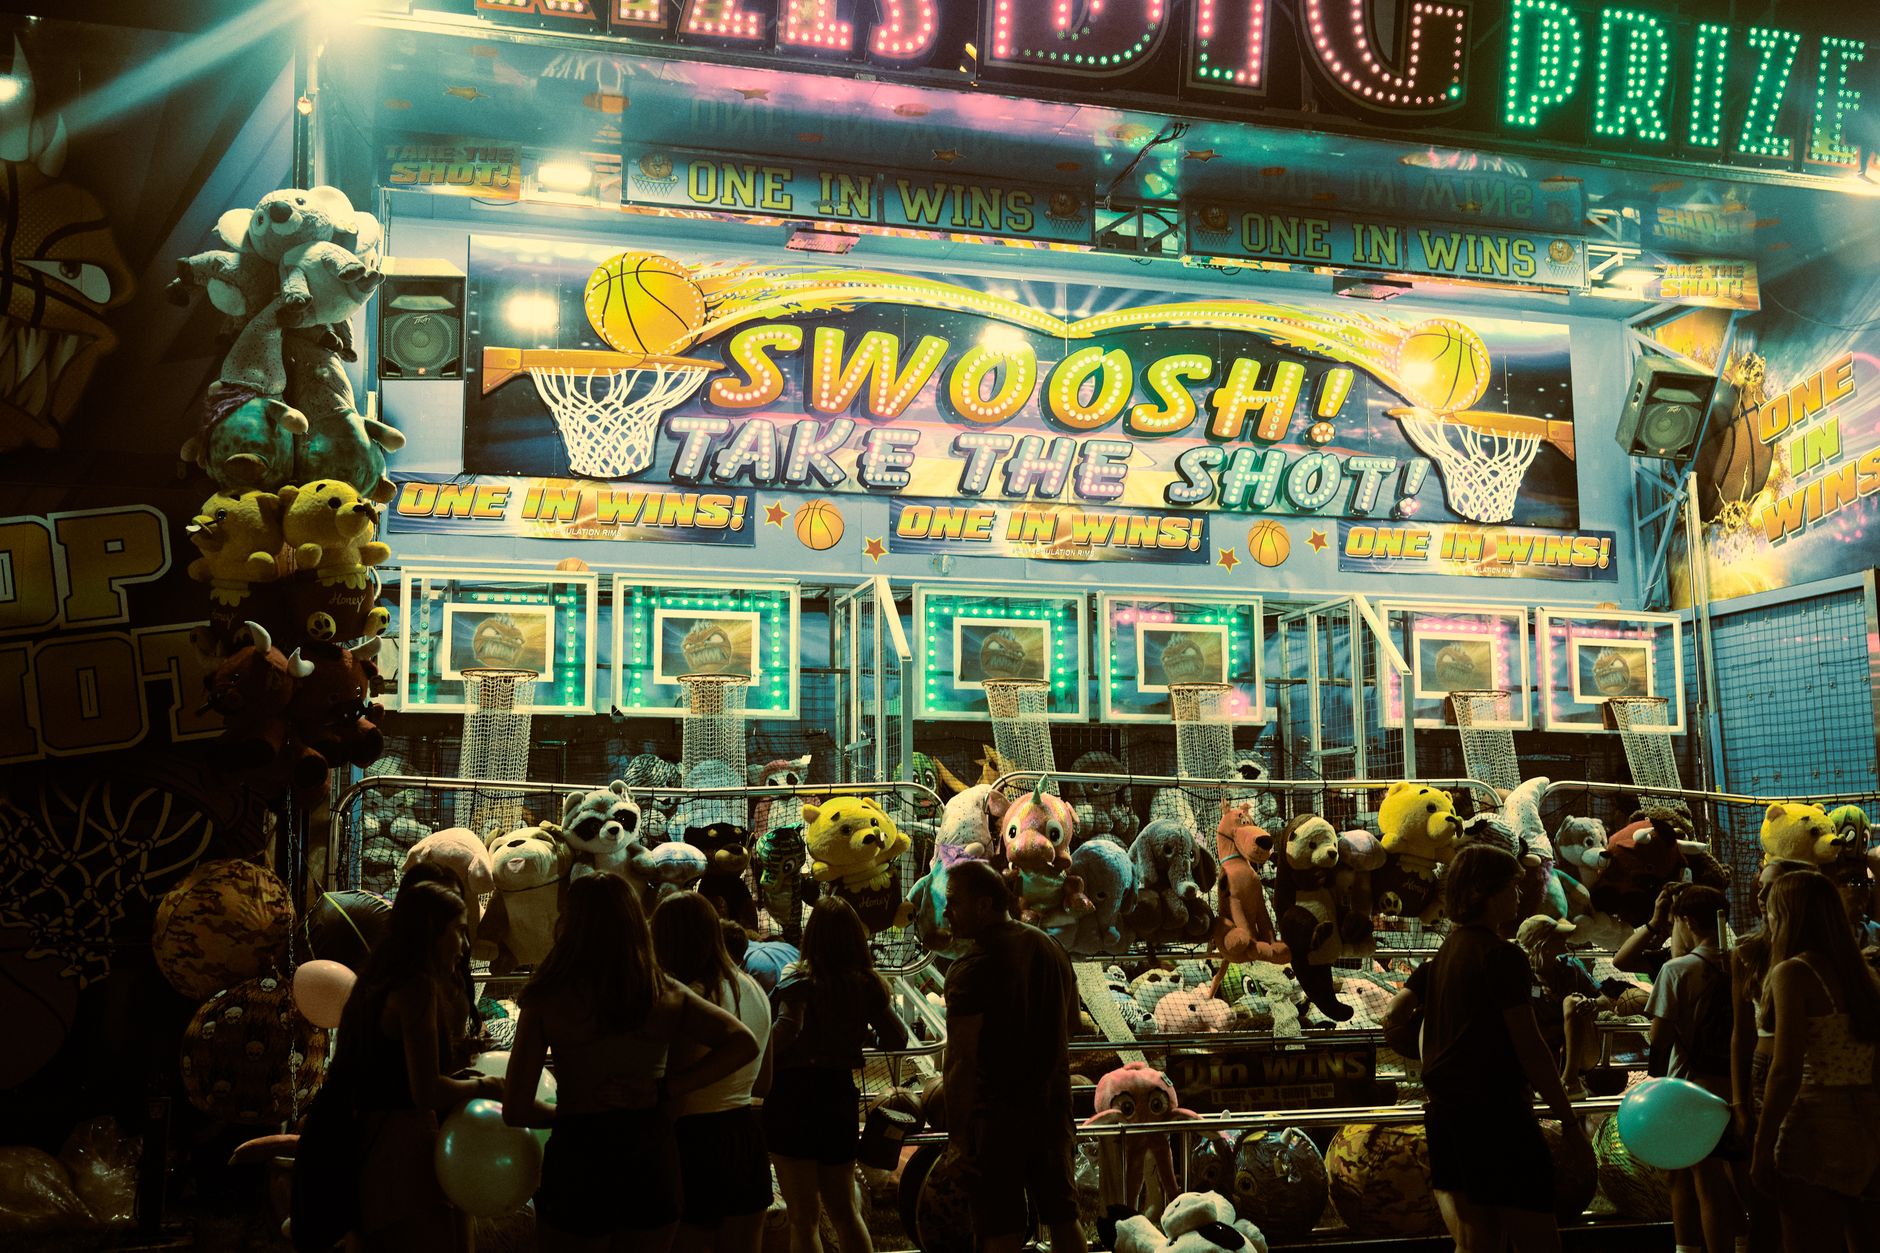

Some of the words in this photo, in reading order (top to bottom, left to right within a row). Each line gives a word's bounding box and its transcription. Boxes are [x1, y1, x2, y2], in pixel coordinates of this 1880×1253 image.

[389, 161, 512, 188] SHOT!
[463, 147, 514, 163] THE
[687, 159, 793, 211] ONE
[817, 169, 872, 223] IN
[899, 178, 1035, 234] WINS
[1241, 211, 1332, 260] ONE
[1353, 222, 1400, 267] IN
[1417, 229, 1537, 278] WINS
[1660, 278, 1744, 300] SHOT!
[1707, 264, 1745, 279] THE
[709, 322, 1355, 447] SWOOSH!
[1758, 351, 1856, 445] ONE
[665, 415, 922, 490] TAKE
[957, 431, 1134, 499] THE
[1168, 447, 1431, 519] SHOT!
[1789, 415, 1842, 479] IN
[397, 482, 511, 519] ONE
[521, 486, 582, 523] IN
[596, 489, 749, 532] WINS!
[1760, 446, 1880, 545] WINS
[896, 505, 996, 541] ONE
[1005, 510, 1060, 545] IN
[1071, 512, 1204, 552] WINS!
[1345, 526, 1431, 560] ONE
[1440, 531, 1485, 563] IN
[1496, 534, 1611, 569] WINS!
[328, 590, 366, 613] Honey
[1210, 1057, 1249, 1085] in
[1262, 1051, 1370, 1083] WINS
